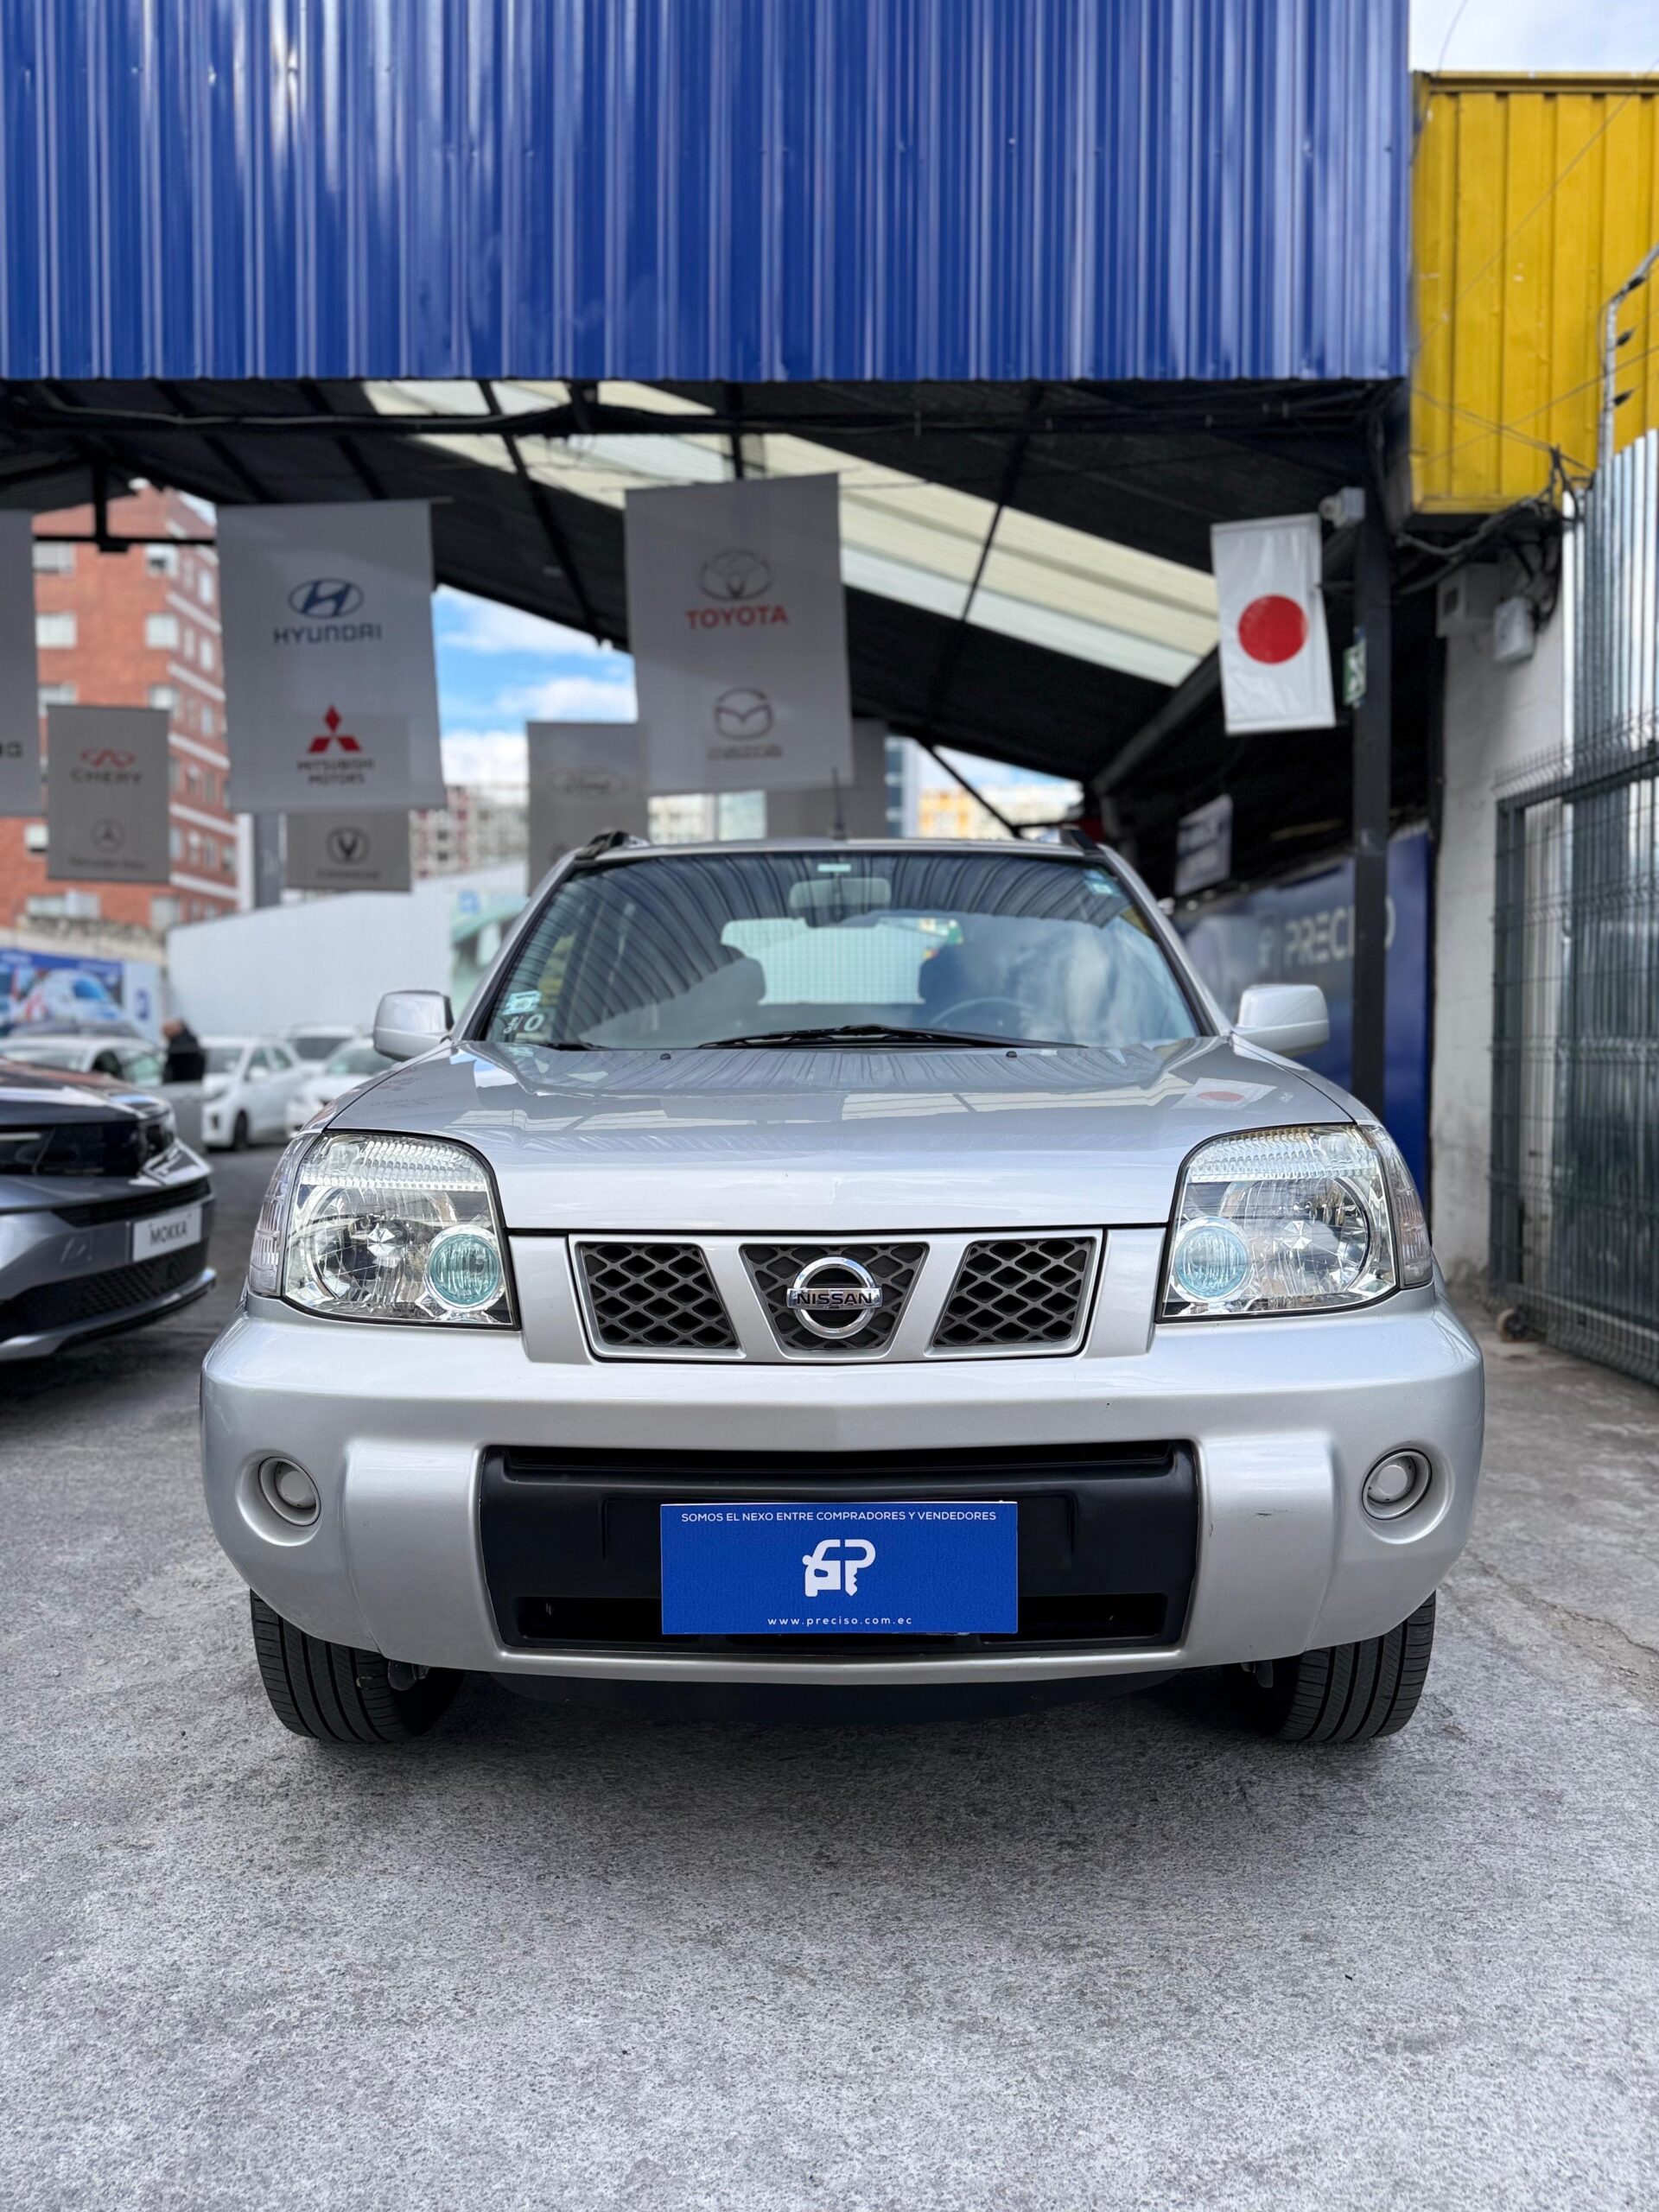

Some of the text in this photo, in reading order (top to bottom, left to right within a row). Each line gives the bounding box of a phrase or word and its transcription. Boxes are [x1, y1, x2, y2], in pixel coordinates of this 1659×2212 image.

[685, 604, 789, 630] TOYOTA
[273, 623, 383, 645] HYUNDAI
[797, 1293, 872, 1305] NISSAN
[681, 1511, 997, 1522] SOMOS EL NEXO ENTRE COMPRADORES Y VENDEDORES
[766, 1616, 913, 1627] www.preciso.com.ec
